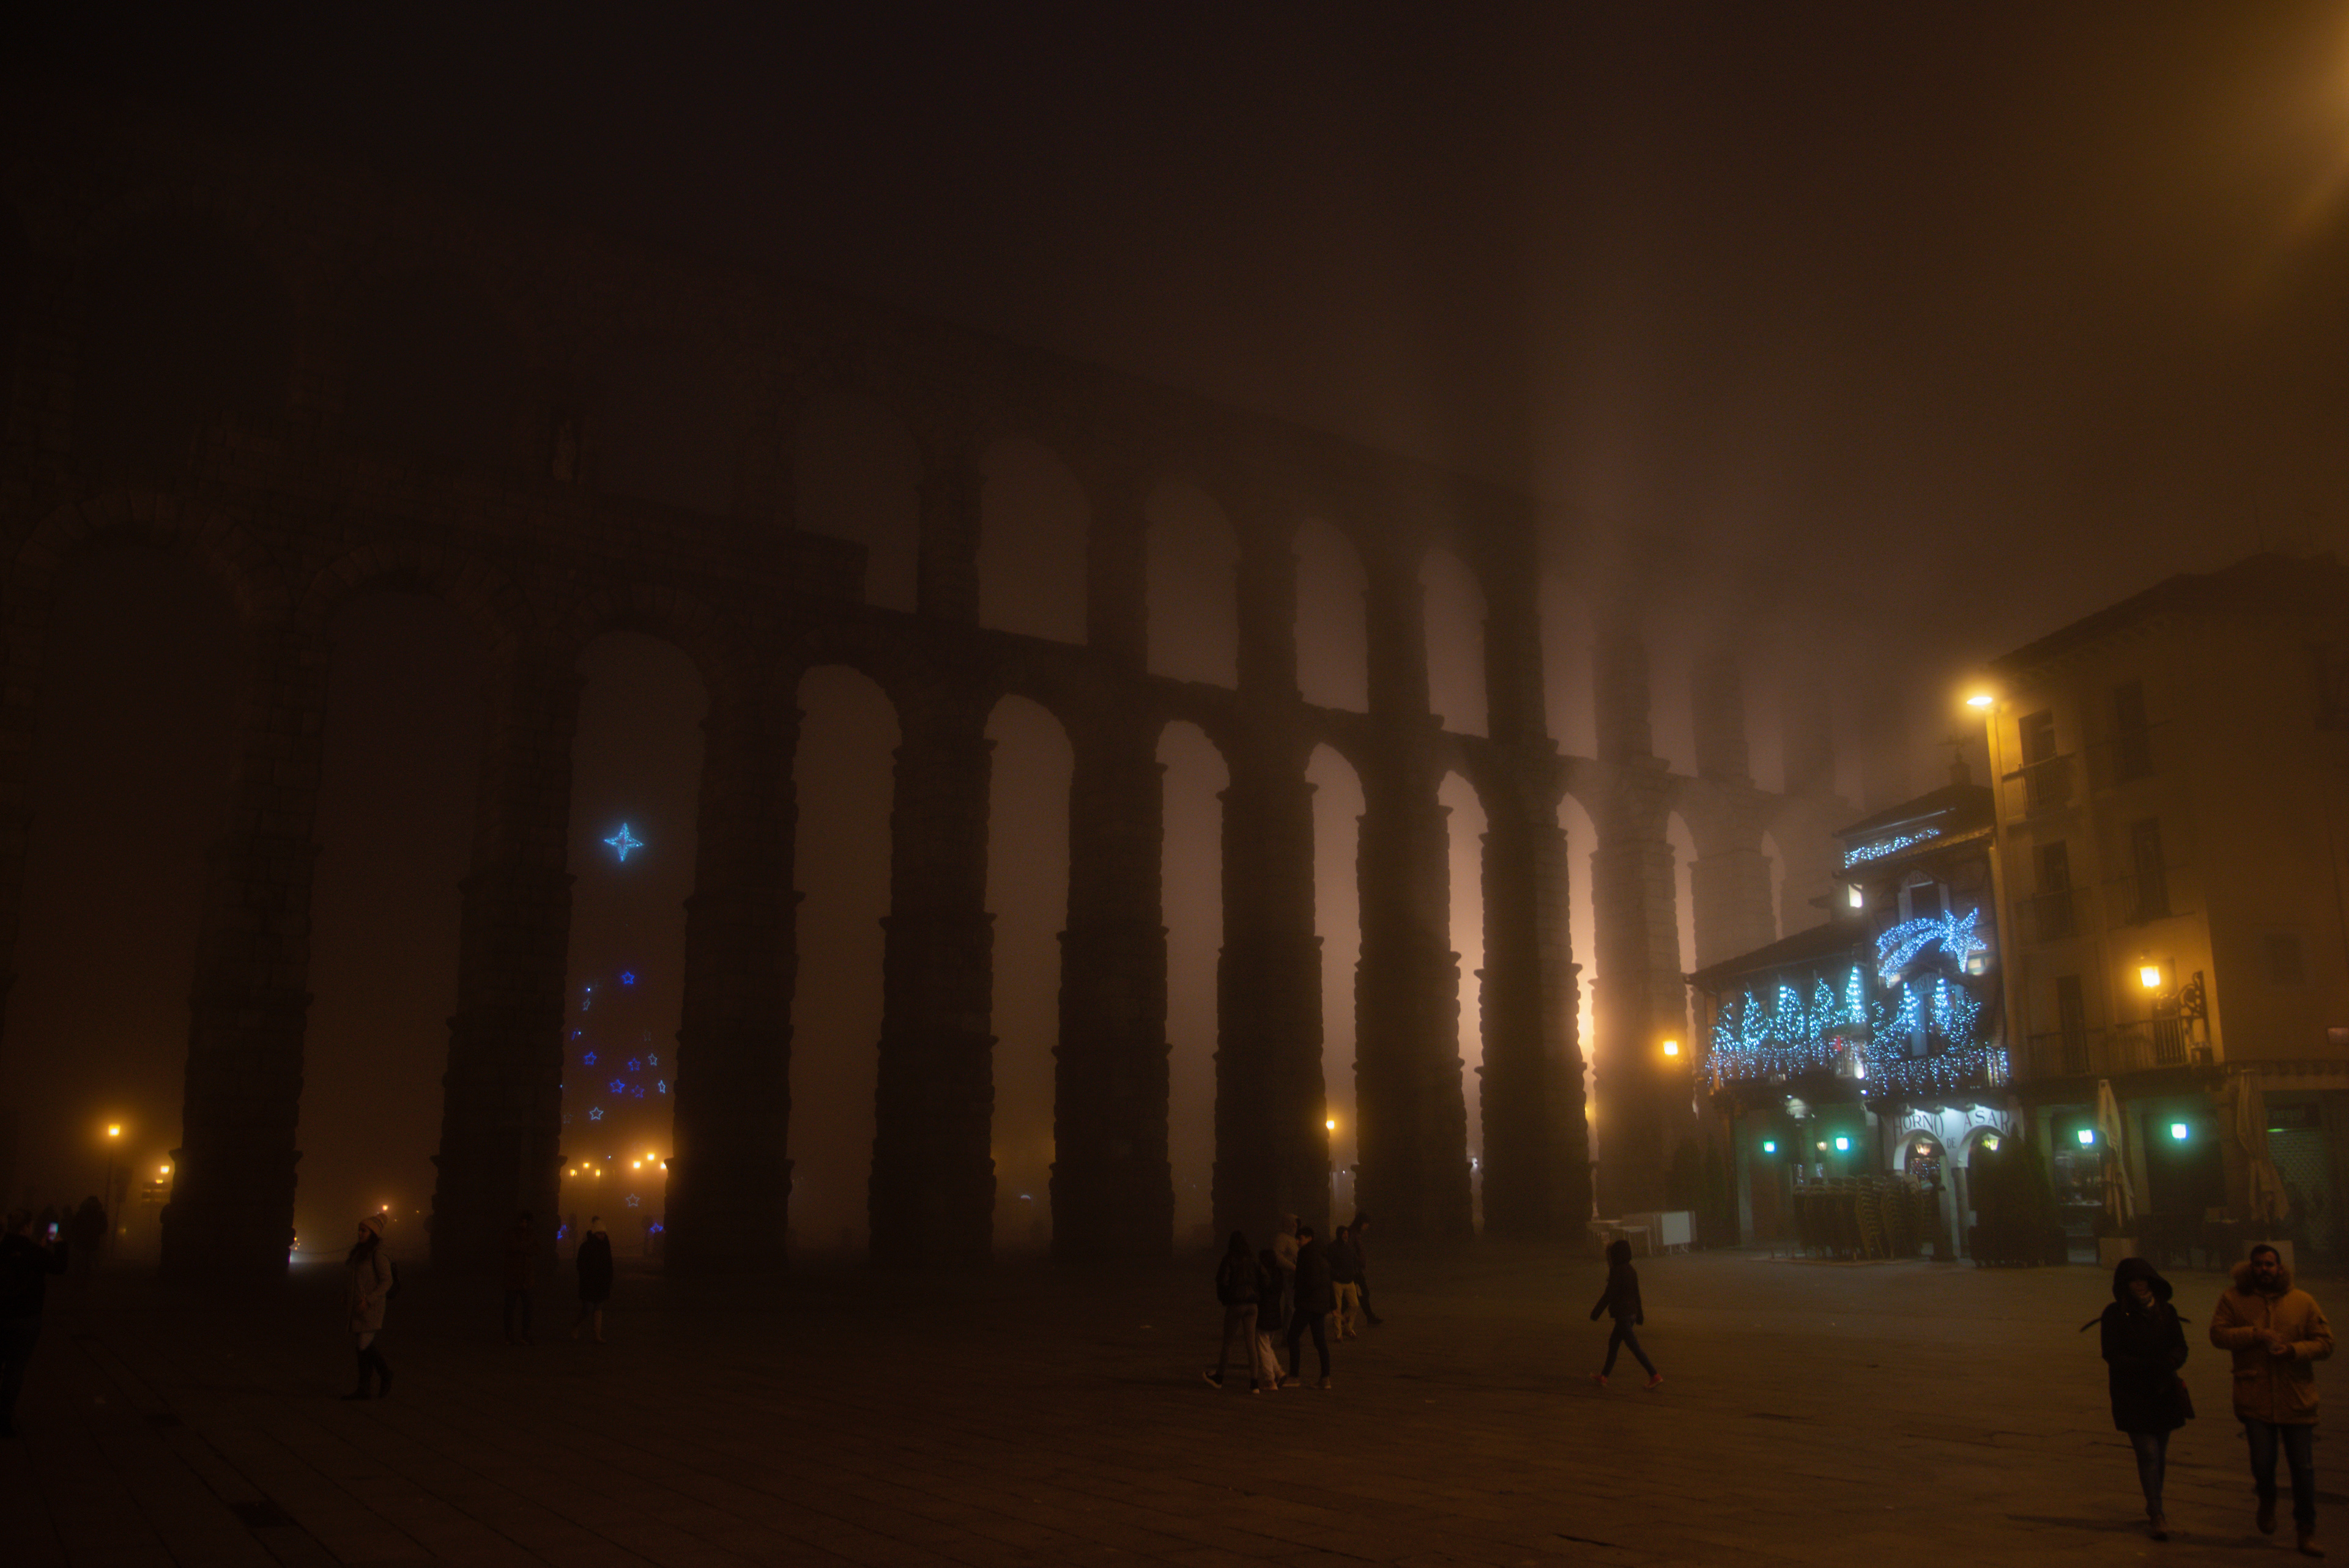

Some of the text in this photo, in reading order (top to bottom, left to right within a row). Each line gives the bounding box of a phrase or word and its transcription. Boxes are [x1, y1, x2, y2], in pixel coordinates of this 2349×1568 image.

[1893, 1110, 2009, 1148] HORNO DE ASAR
